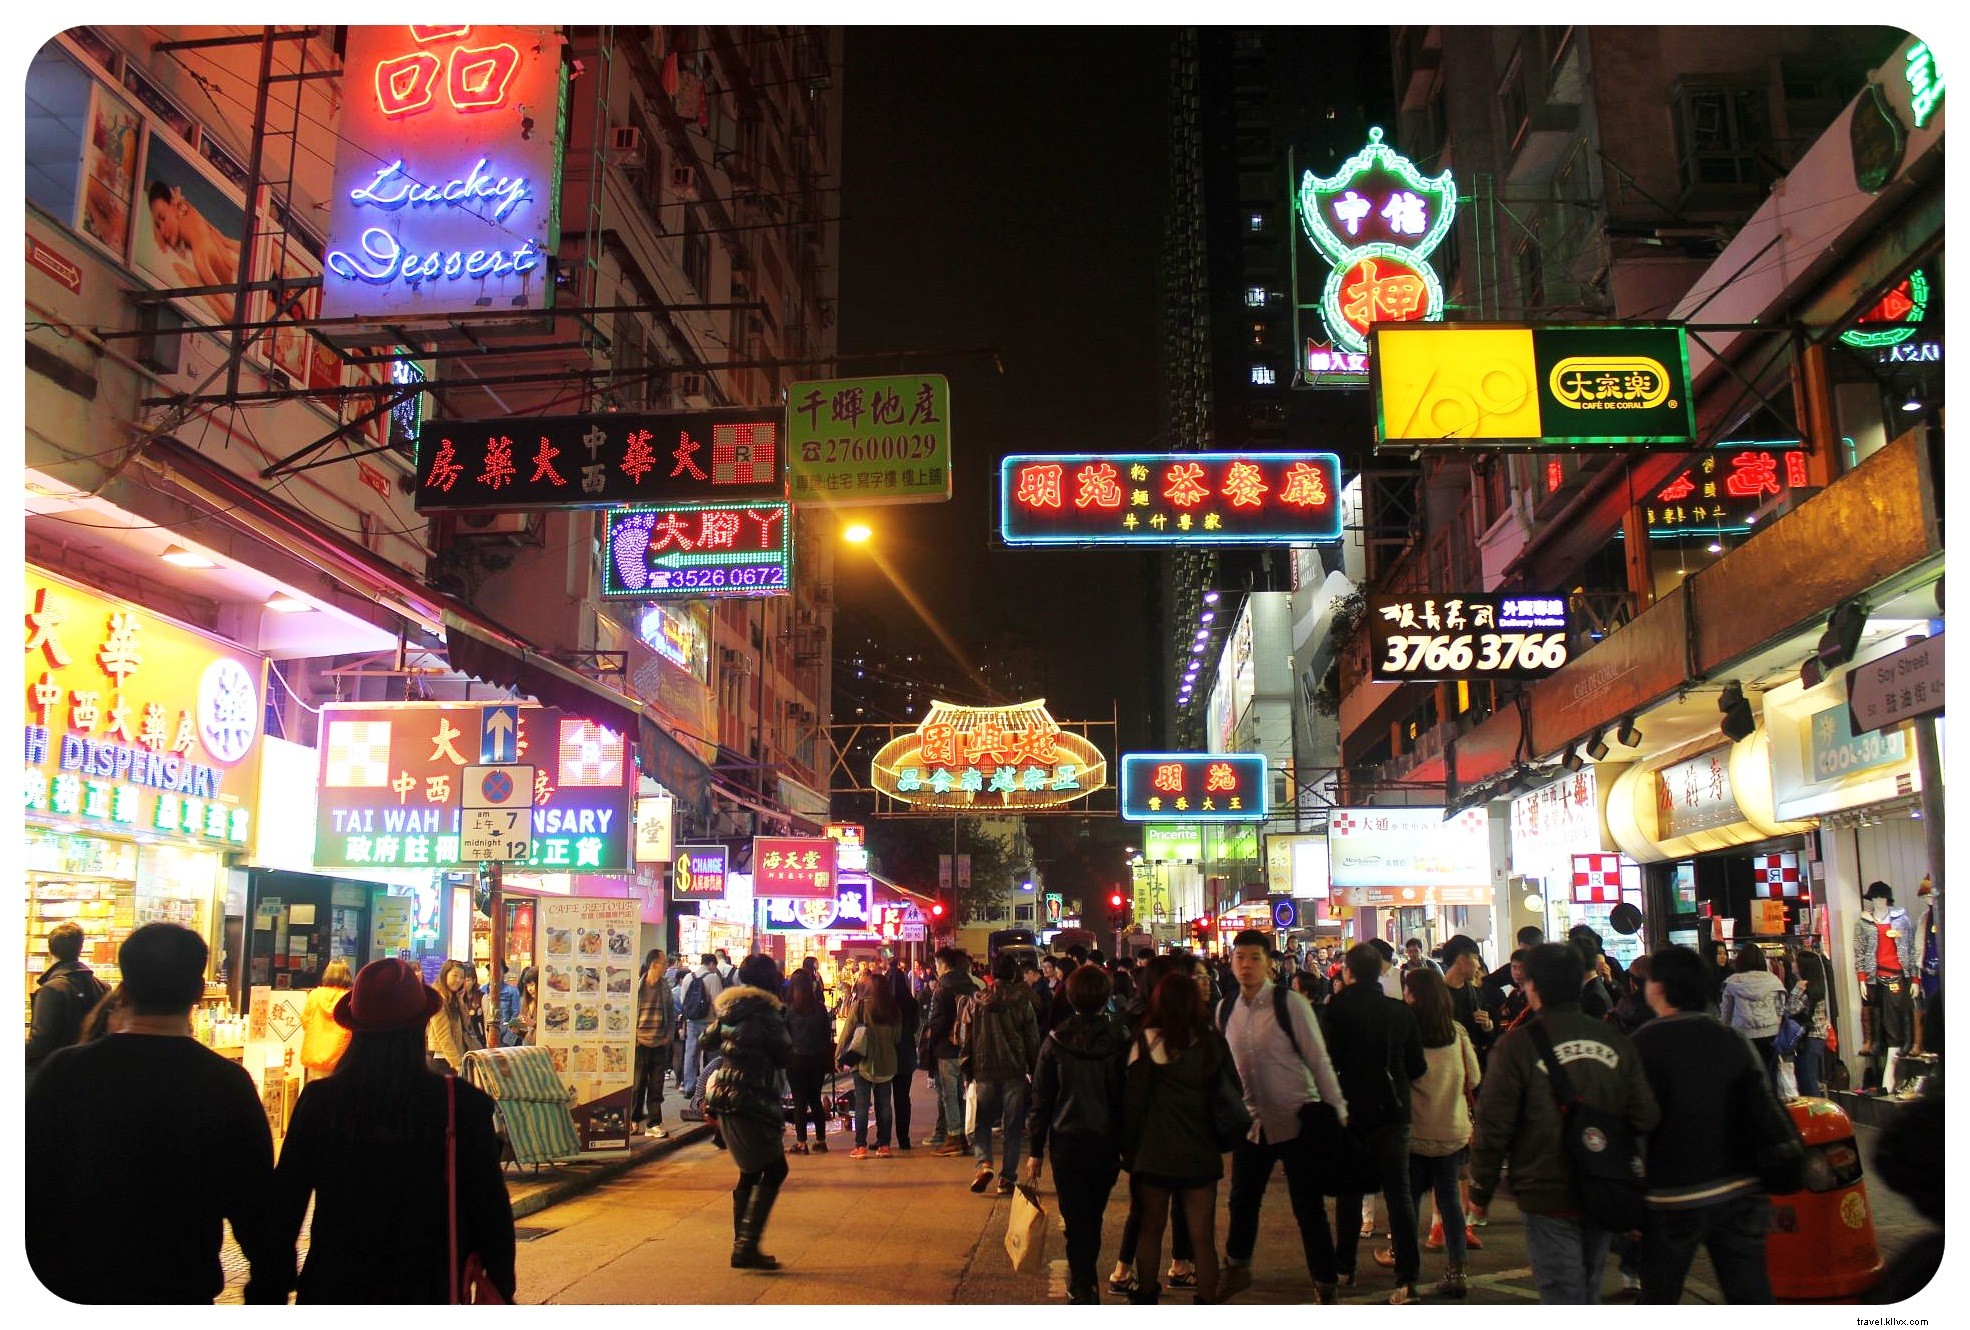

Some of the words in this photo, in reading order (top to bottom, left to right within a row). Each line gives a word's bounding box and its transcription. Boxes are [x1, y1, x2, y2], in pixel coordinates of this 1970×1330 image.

[350, 158, 533, 217] Lucky
[327, 226, 536, 280] Dessert
[1344, 259, 1425, 329] 押
[825, 433, 936, 463] 27600029
[1017, 464, 1122, 508] 明苑
[1163, 462, 1328, 507] 茶餐廳
[650, 509, 784, 551] 大腳丫
[672, 569, 725, 588] 3526
[730, 567, 783, 585] 0672
[25, 588, 142, 689] 大華
[1381, 634, 1474, 671] 3766
[1476, 632, 1567, 670] 3766
[1877, 666, 1895, 684] Soy
[1898, 651, 1930, 675] Street
[27, 672, 198, 758] 中西大藥房
[60, 734, 224, 799] DISPENSARY
[332, 809, 373, 833] TAI
[384, 809, 439, 833] WAH
[473, 820, 494, 830] 上午
[506, 812, 518, 830] 7
[464, 839, 501, 847] midnight
[506, 841, 528, 859] 12
[472, 849, 494, 859] 午夜
[762, 850, 821, 870] 海天堂
[692, 858, 723, 874] CHANGE
[549, 904, 579, 915] CAFE
[583, 902, 633, 912] RETOUR
